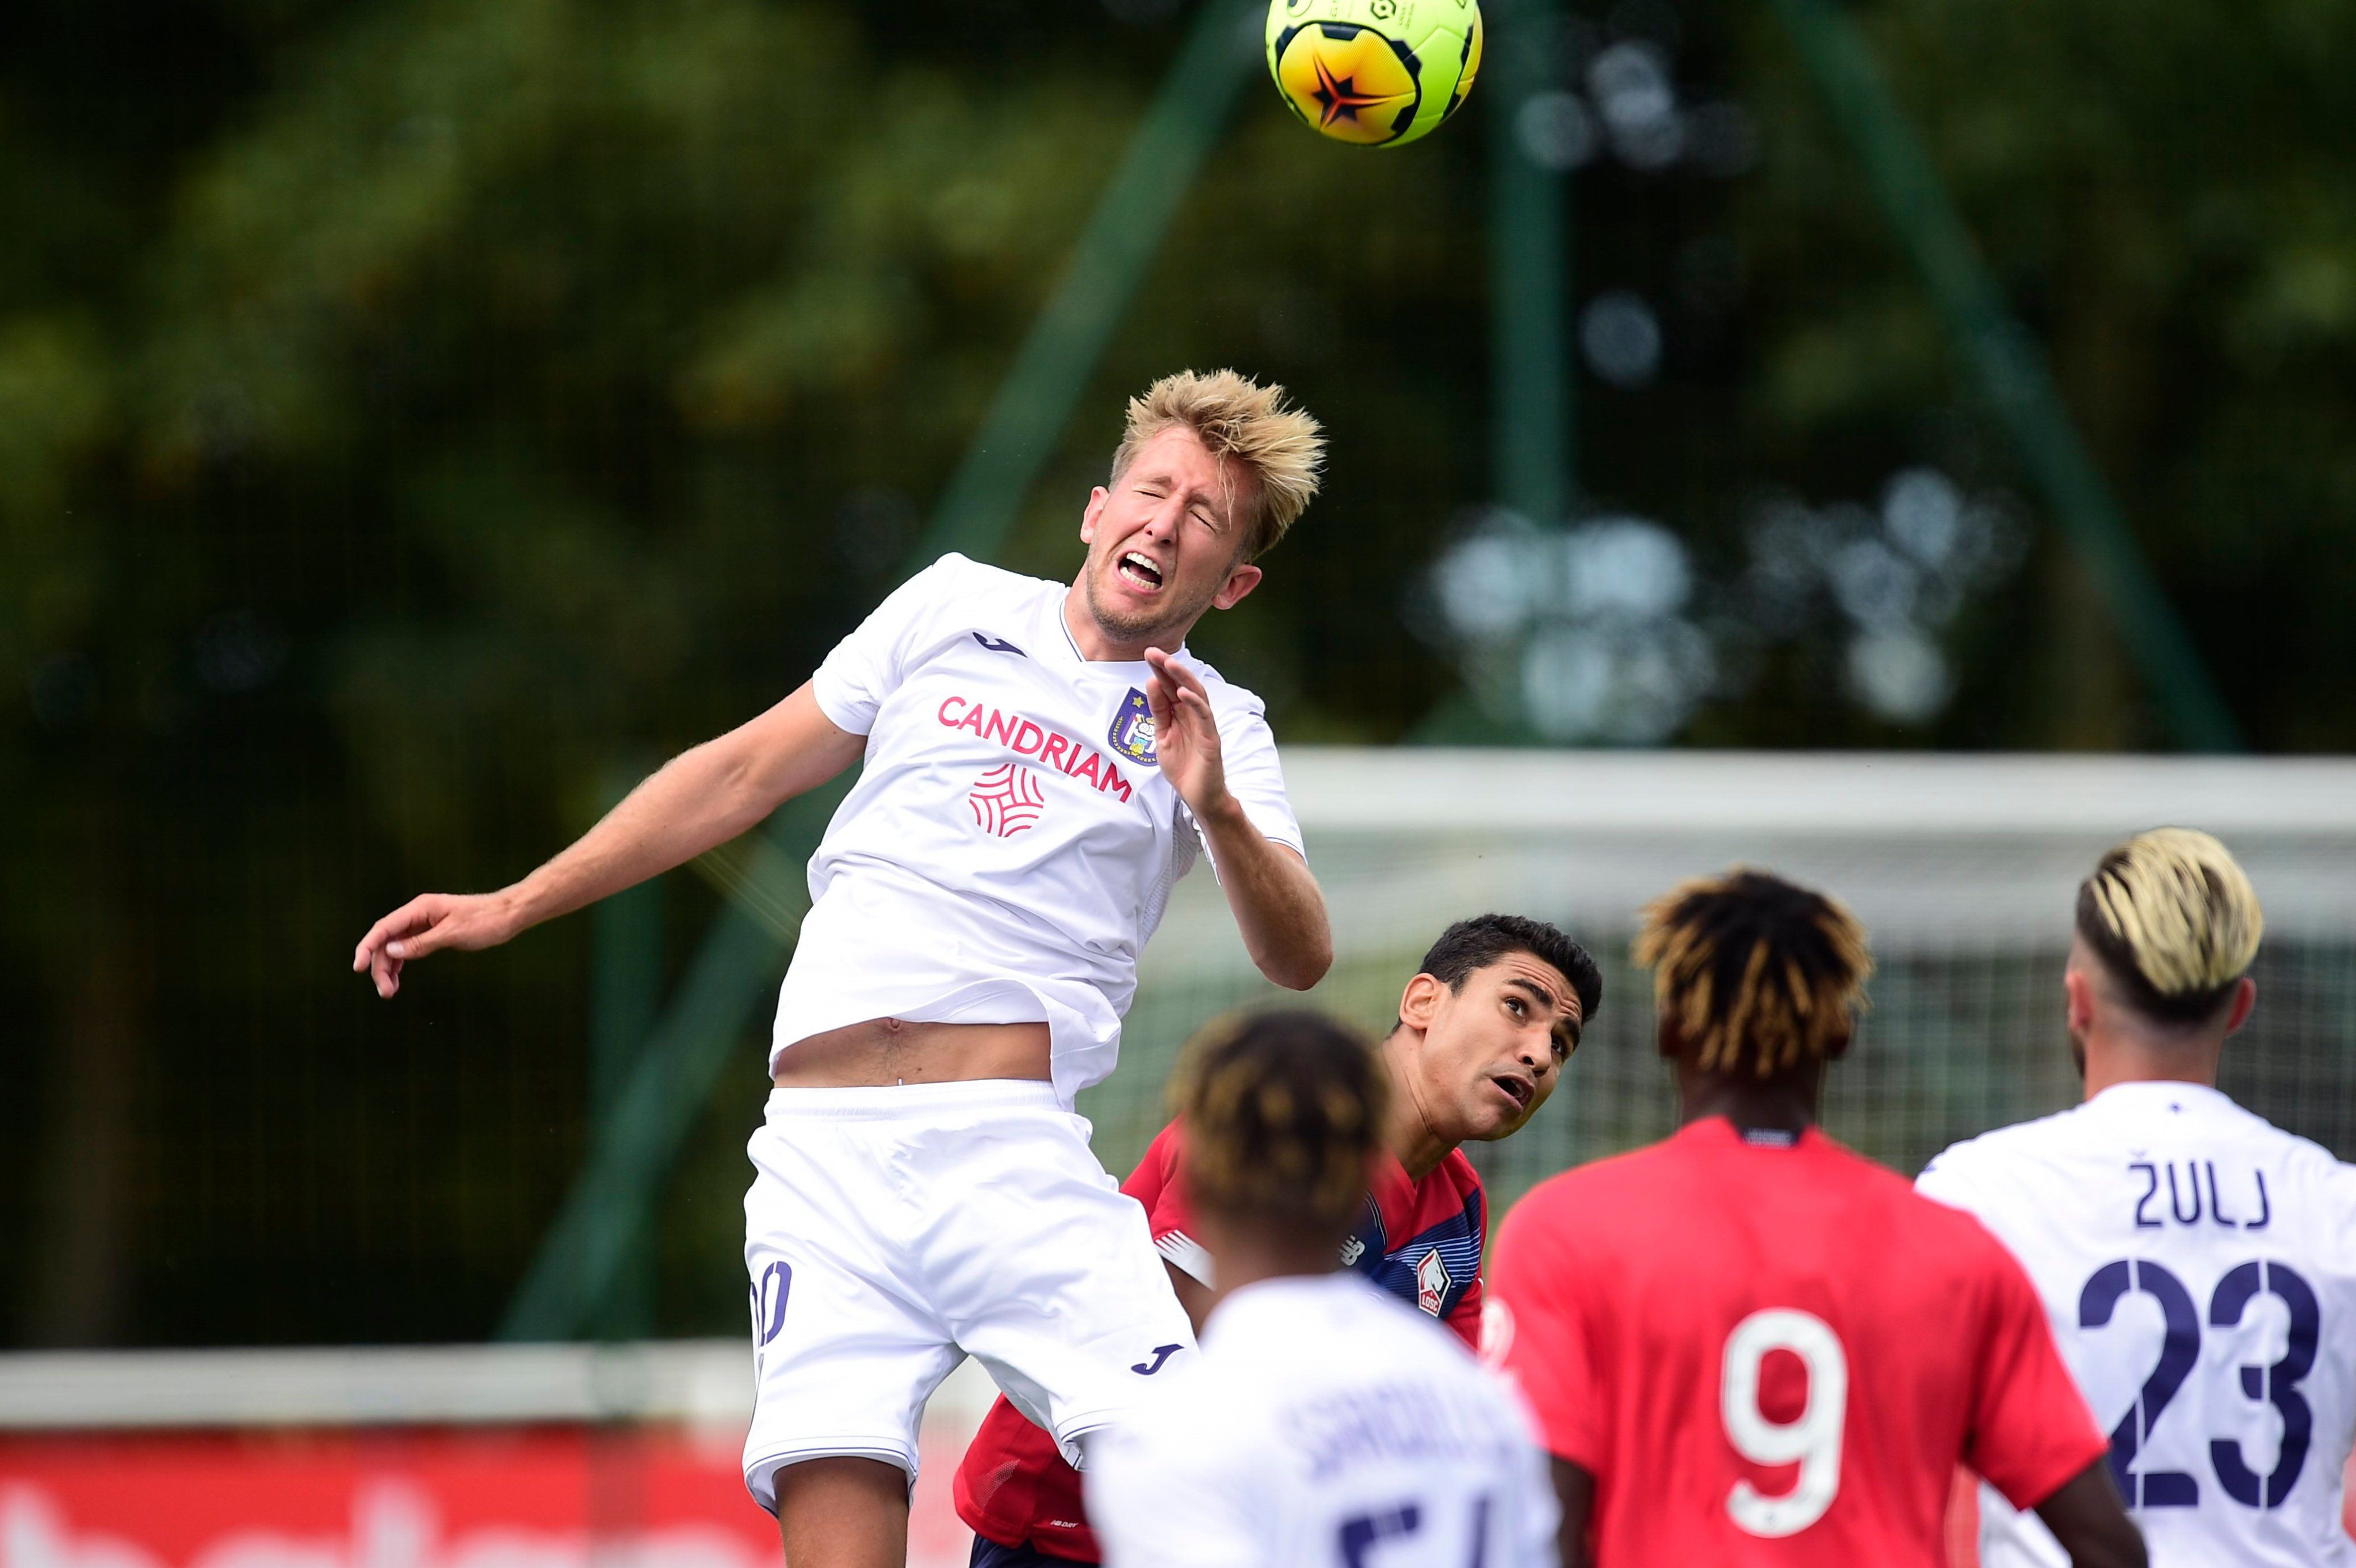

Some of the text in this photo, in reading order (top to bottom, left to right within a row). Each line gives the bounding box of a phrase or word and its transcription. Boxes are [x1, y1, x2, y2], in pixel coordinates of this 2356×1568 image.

[938, 696, 1133, 804] CANDRIAM
[1421, 1294, 1439, 1312] LOSC
[2079, 1260, 2320, 1509] 23
[1720, 1306, 1849, 1539] 9
